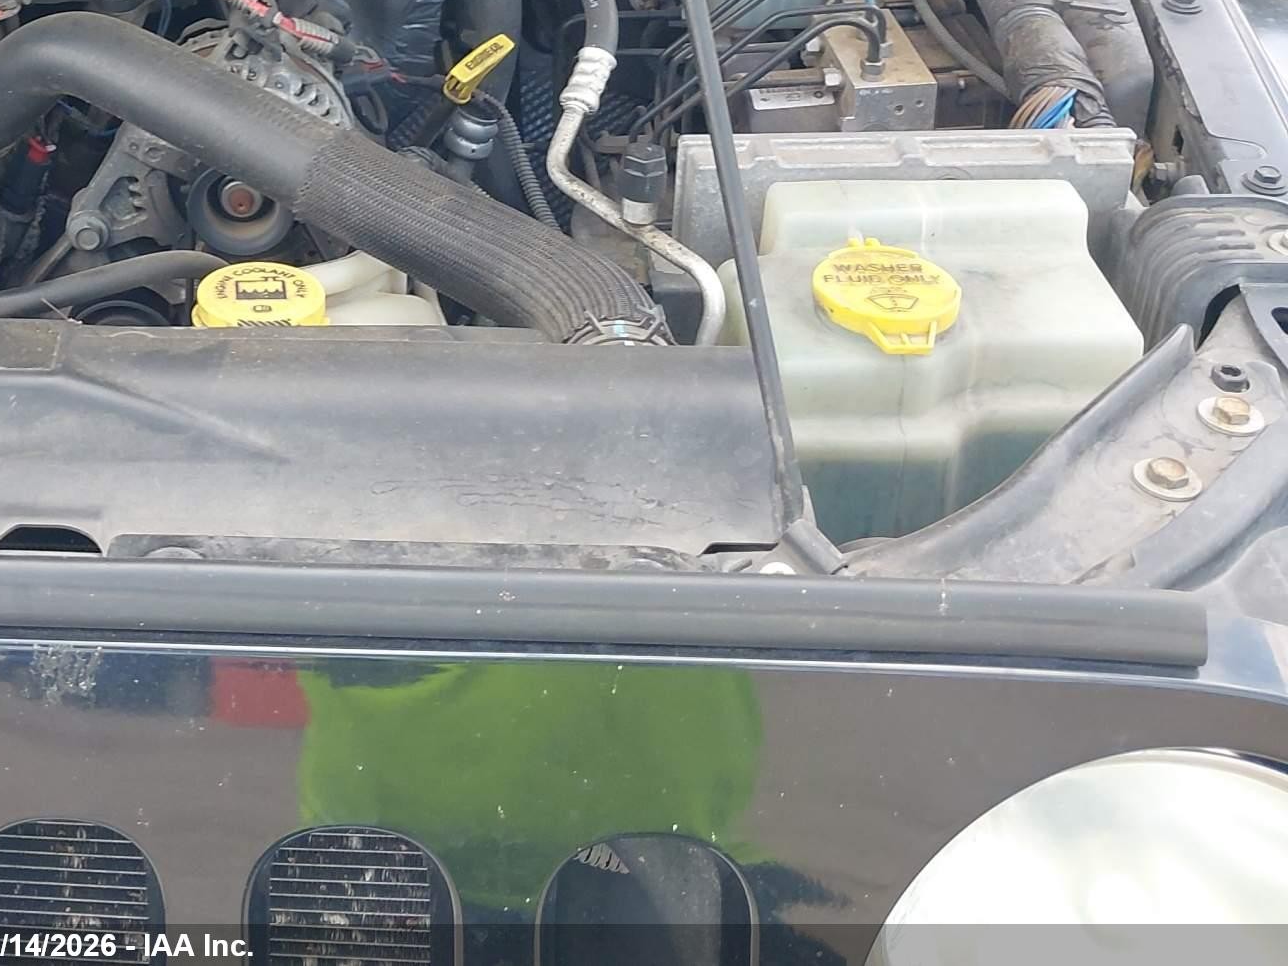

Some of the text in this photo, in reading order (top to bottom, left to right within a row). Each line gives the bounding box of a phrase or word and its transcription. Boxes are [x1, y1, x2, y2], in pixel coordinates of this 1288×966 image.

[833, 263, 923, 273] WASHER
[233, 267, 296, 279] COOLANT
[292, 278, 308, 298] ONLY
[823, 274, 941, 284] FLUID ONLY
